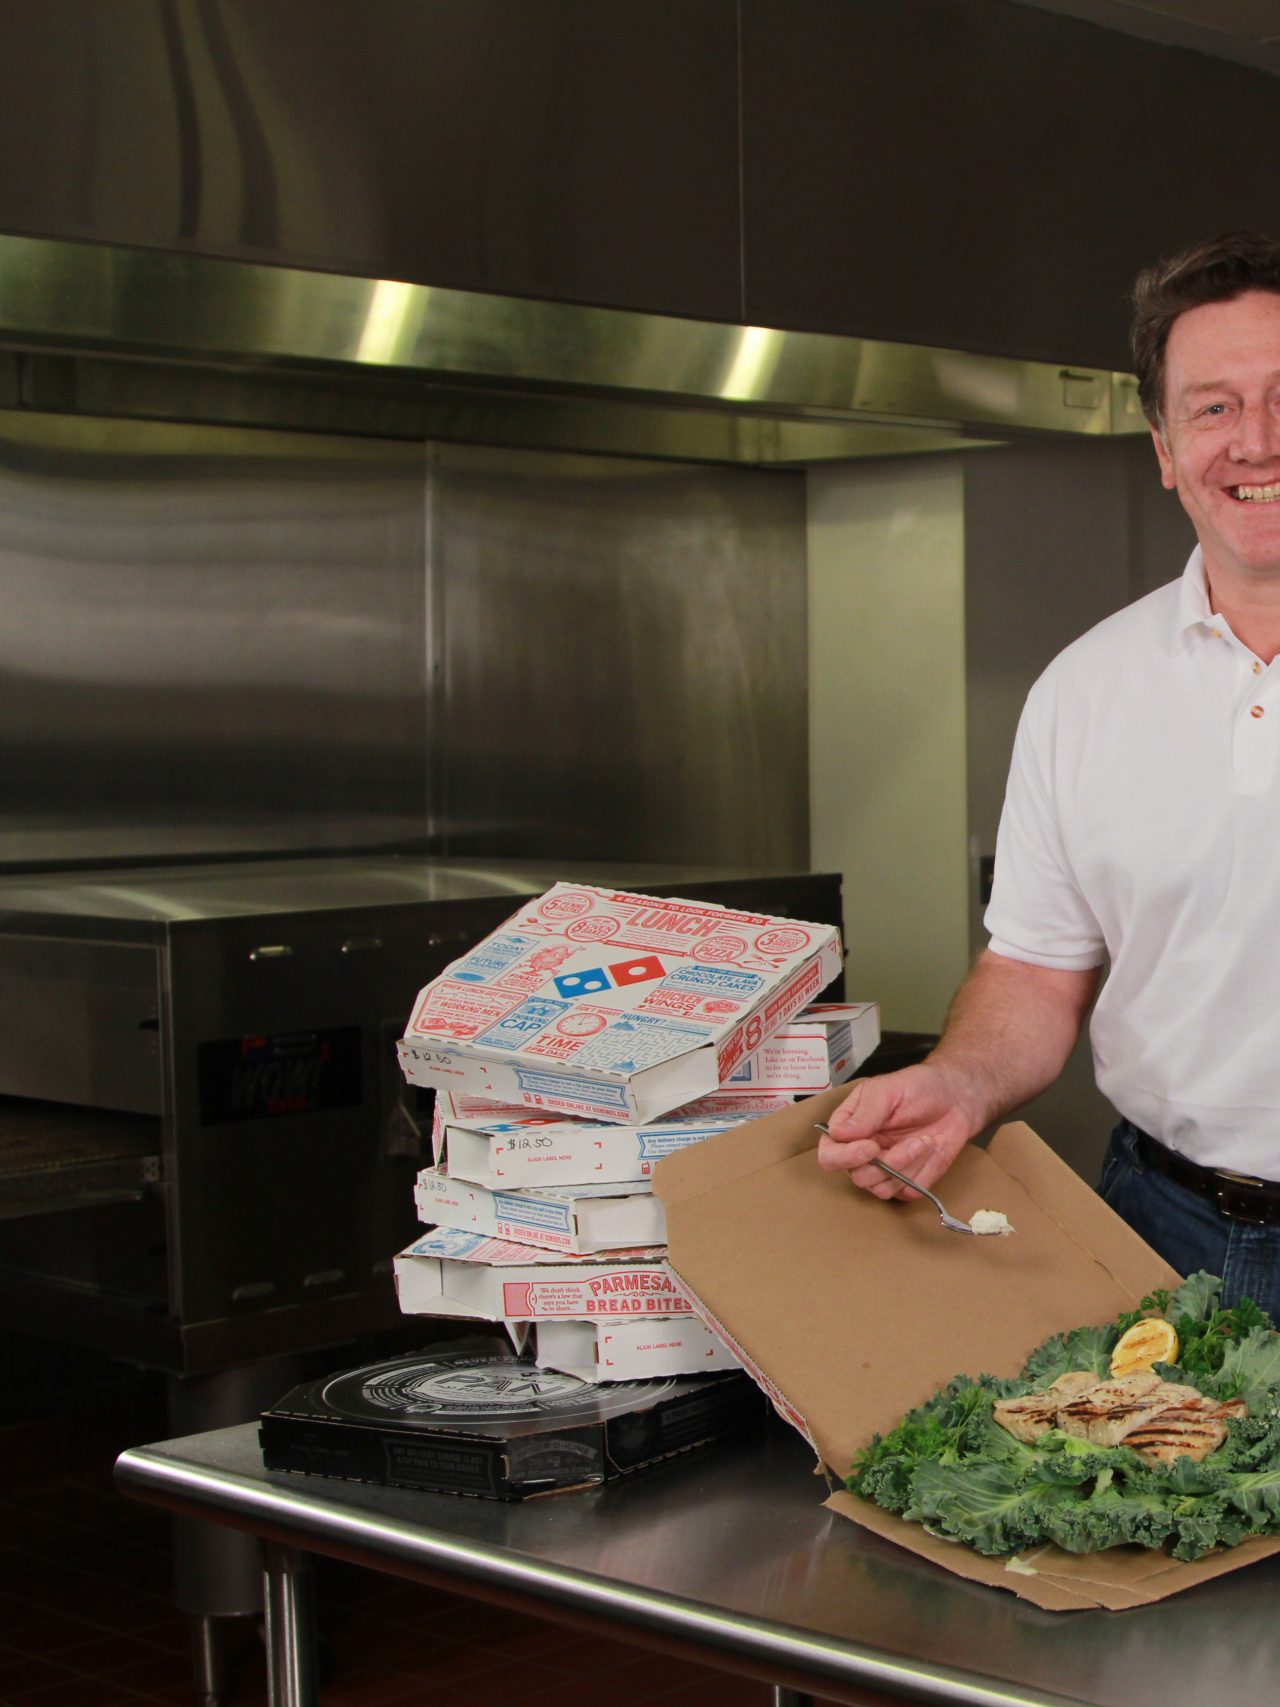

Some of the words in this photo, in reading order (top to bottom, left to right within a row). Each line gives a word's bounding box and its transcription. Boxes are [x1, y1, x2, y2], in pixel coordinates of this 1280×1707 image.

[624, 897, 665, 909] REASONS
[680, 906, 704, 916] LOOK
[706, 909, 747, 922] FORWARD
[626, 908, 721, 937] LUNCH
[760, 934, 778, 946] 3
[695, 946, 734, 958] PIZZA
[470, 957, 510, 967] FUTURE
[510, 974, 544, 983] FINALLY
[670, 974, 718, 985] CRUNCH
[719, 981, 758, 991] CAKES
[679, 969, 735, 982] CHOCOLATE
[735, 976, 758, 985] LAVA
[643, 997, 697, 1010] WINGS
[649, 990, 704, 1004] CHICKEN
[439, 1001, 483, 1014] WORKING
[484, 1009, 502, 1017] MEN
[500, 1019, 541, 1032] CAP
[620, 1013, 666, 1025] HUNGRY?
[745, 1013, 762, 1050] 8
[536, 1035, 585, 1050] TIME
[524, 1045, 545, 1053] 2PM
[546, 1049, 572, 1058] DAILY
[589, 1275, 677, 1296] PARMESA
[586, 1299, 641, 1312] BREAD
[646, 1298, 692, 1311] BITES
[437, 1375, 566, 1394] PAN
